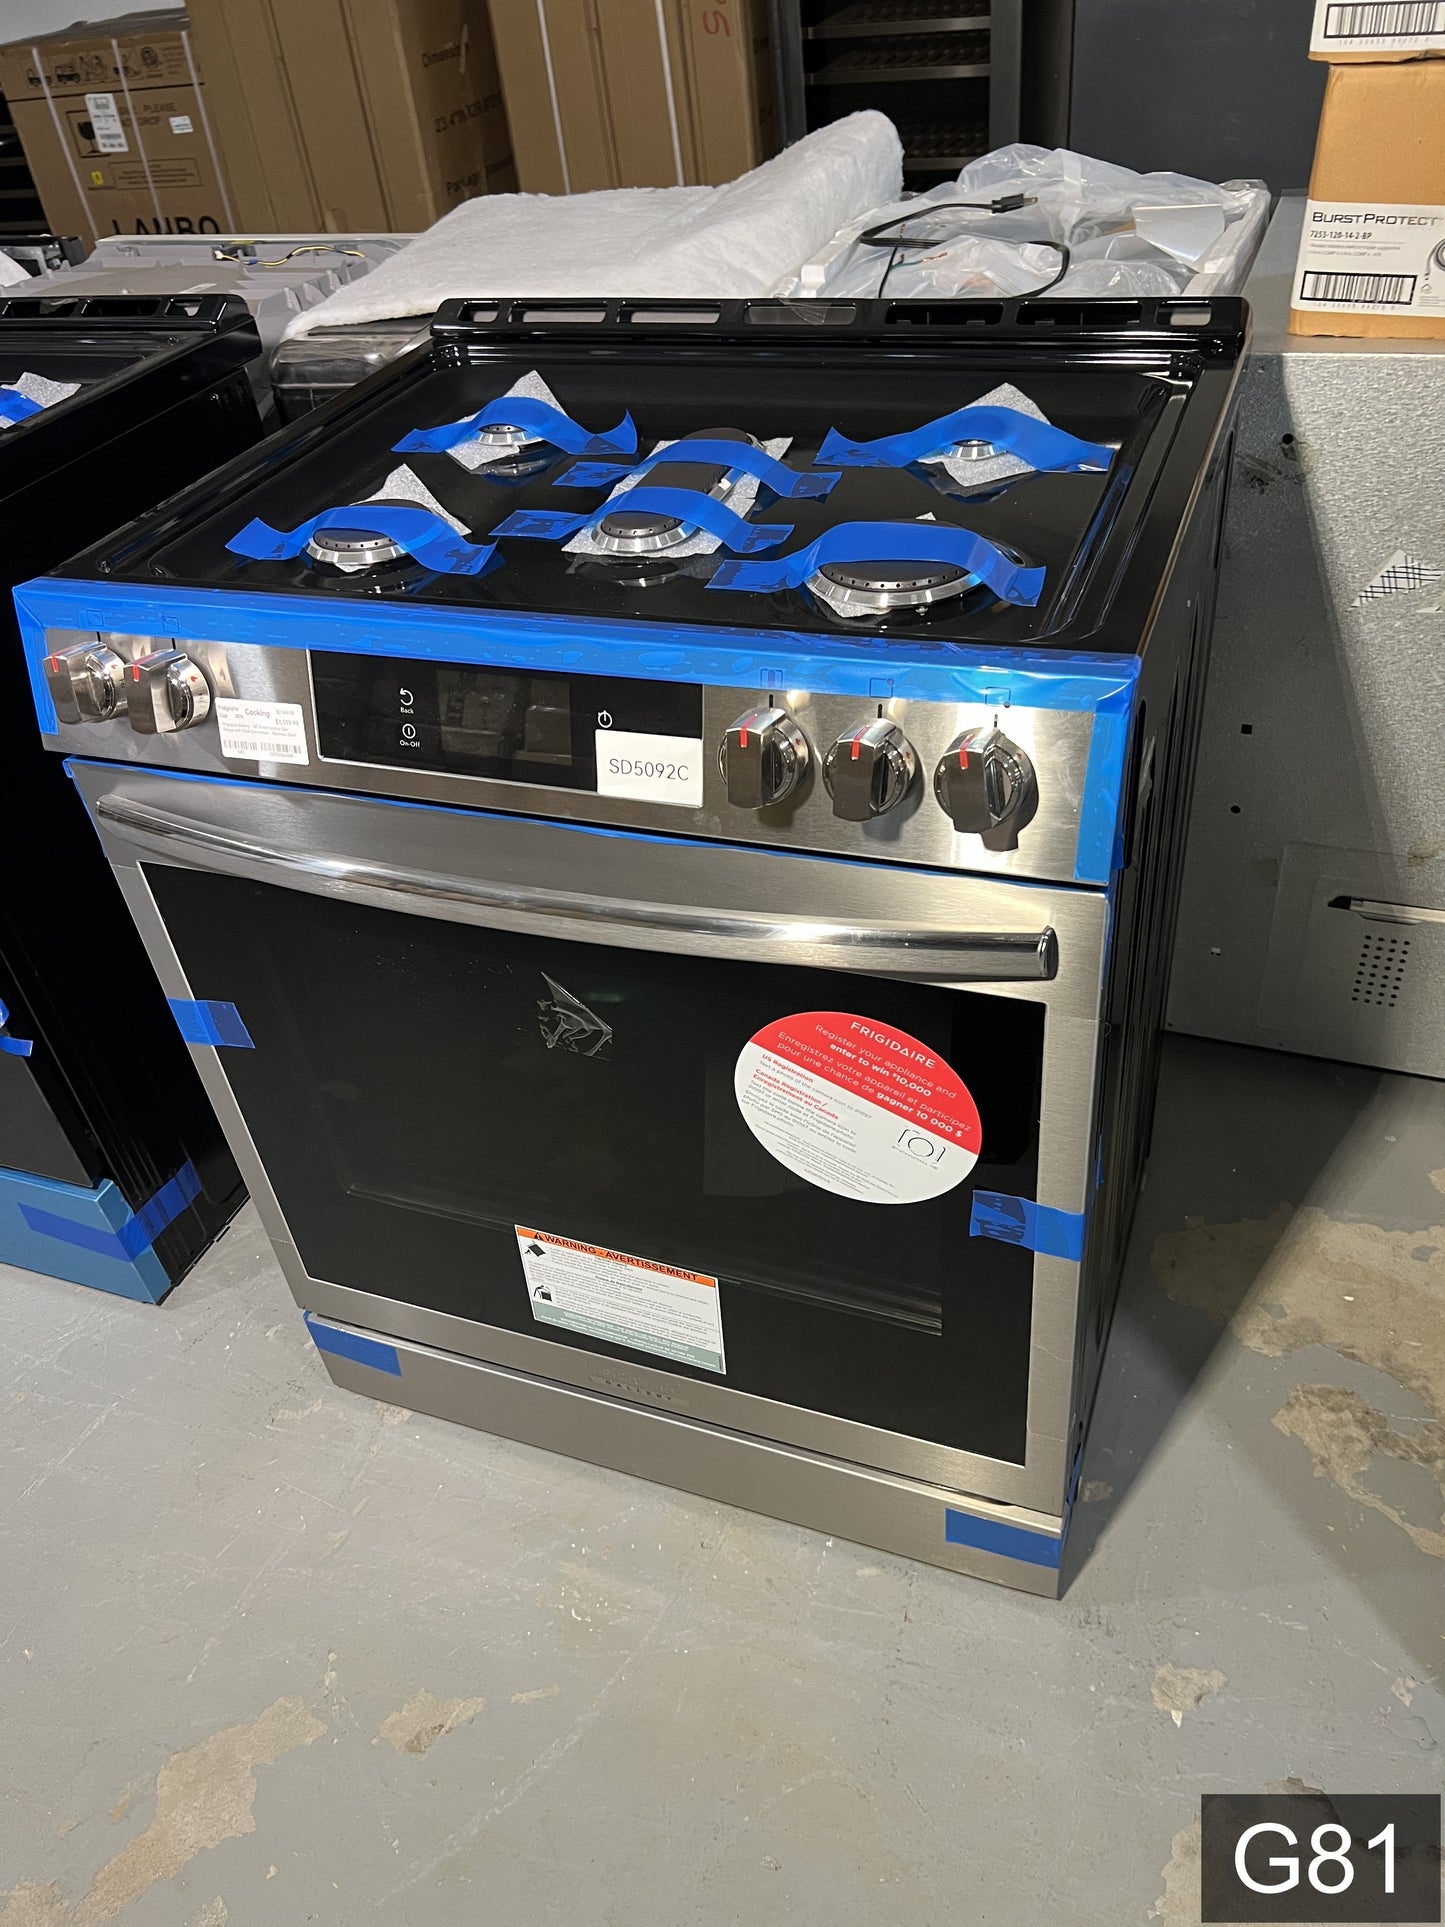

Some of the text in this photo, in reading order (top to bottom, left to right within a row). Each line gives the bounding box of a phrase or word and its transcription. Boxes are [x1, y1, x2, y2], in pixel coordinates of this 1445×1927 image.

[244, 708, 270, 719] Cooking
[400, 706, 414, 714] Back
[399, 739, 420, 748] On-Off
[608, 757, 690, 782] SD5092C
[816, 1025, 956, 1099] Register your appliance and
[850, 1021, 937, 1069] FRIGIDAIRE
[756, 1068, 780, 1083] Canada
[782, 1081, 822, 1104] Registration
[773, 1059, 814, 1082] Registration
[777, 1069, 794, 1080] photo
[778, 1031, 972, 1131] Enregistrez votre appareil et participez
[830, 1043, 931, 1098] enter to win $10,000
[753, 1074, 803, 1101] Enregistrement
[814, 1104, 839, 1119] Canada
[777, 1042, 964, 1138] pour une chance de gagner 10 000 $
[545, 1234, 596, 1254] WARNING
[606, 1251, 698, 1281] AVERTISSEMENT
[605, 1379, 672, 1401] GALLERY
